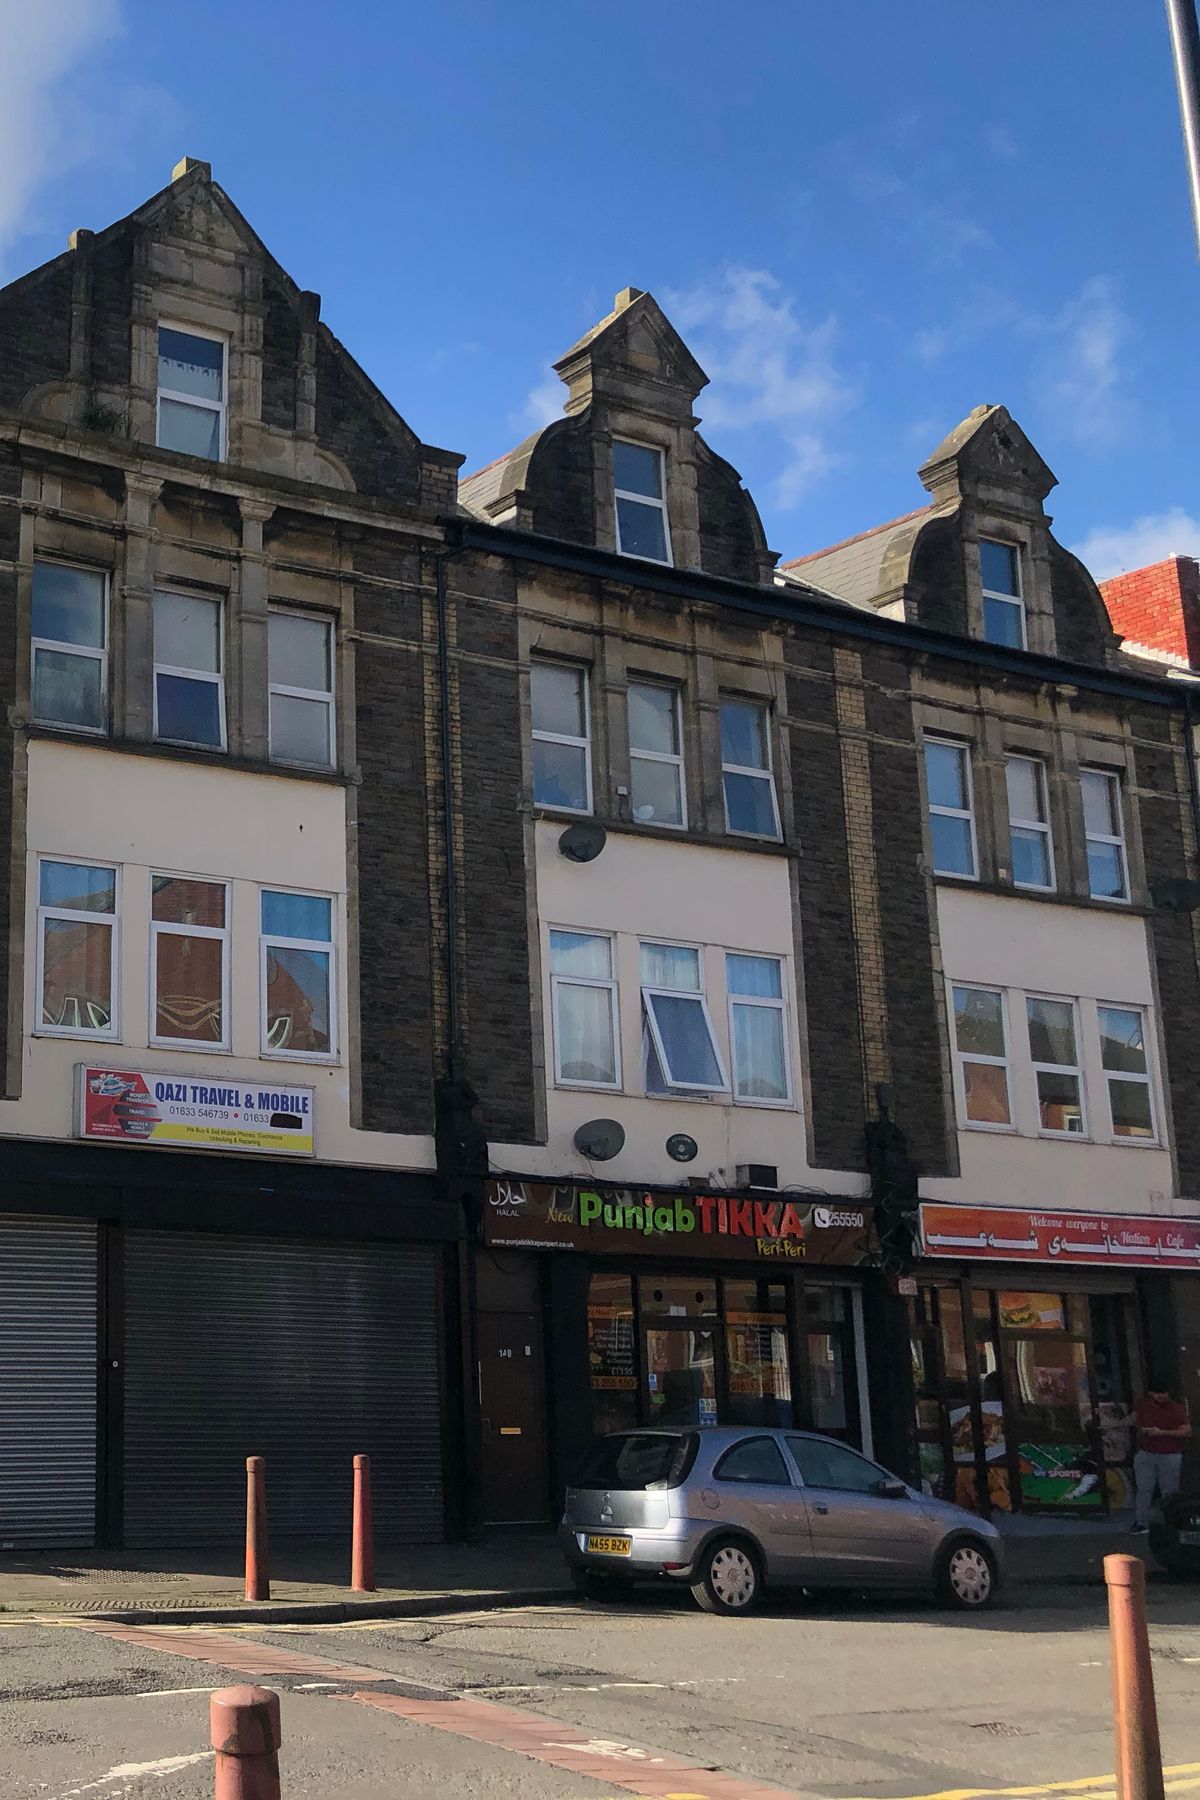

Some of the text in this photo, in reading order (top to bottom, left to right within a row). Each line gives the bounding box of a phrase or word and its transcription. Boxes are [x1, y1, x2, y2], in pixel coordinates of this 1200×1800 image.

[155, 1082, 309, 1114] QAZI TRAVEL & MOBILE
[169, 1105, 269, 1124] 01633 546739 01633
[209, 1135, 233, 1144] Unlocking
[496, 1208, 520, 1217] HALAL
[544, 1192, 806, 1239] New Punjab TIKKA
[1029, 1214, 1109, 1233] Welcome everyone to
[756, 1238, 807, 1257] Peri-Peri
[588, 1538, 629, 1552] NA55 BZK
